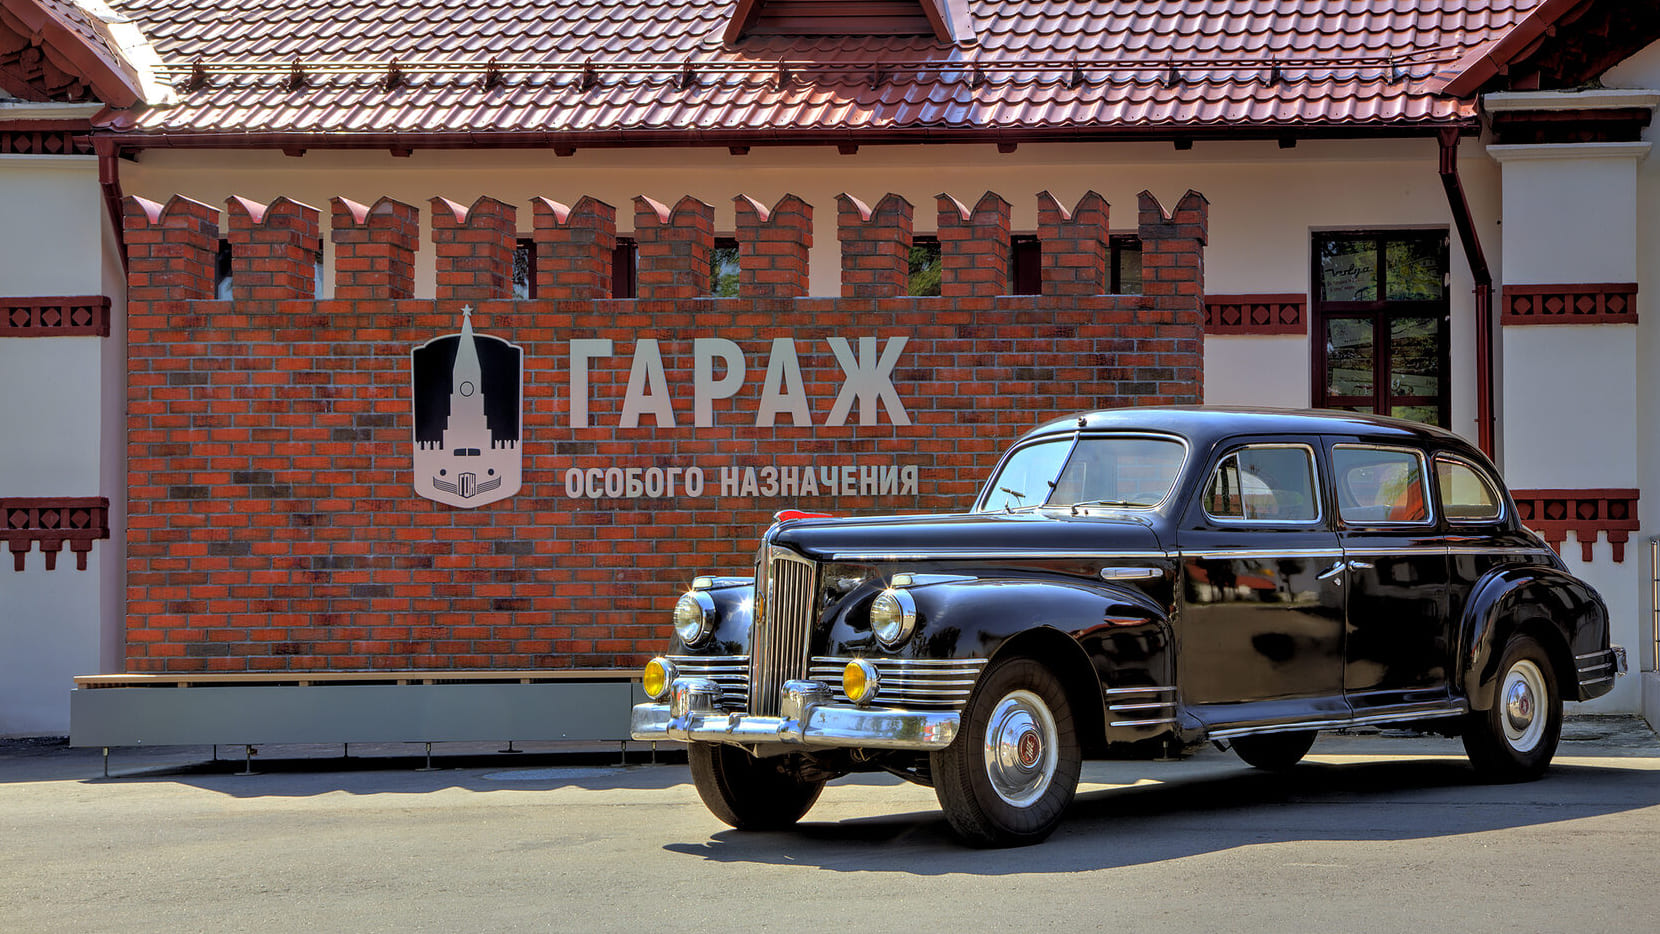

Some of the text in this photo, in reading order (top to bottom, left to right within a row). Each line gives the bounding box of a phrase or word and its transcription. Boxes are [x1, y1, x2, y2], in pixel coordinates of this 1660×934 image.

[569, 336, 911, 428] ГАРАЖ
[565, 465, 918, 498] ОСОБОГО НАЗНАЧЕНИЯ
